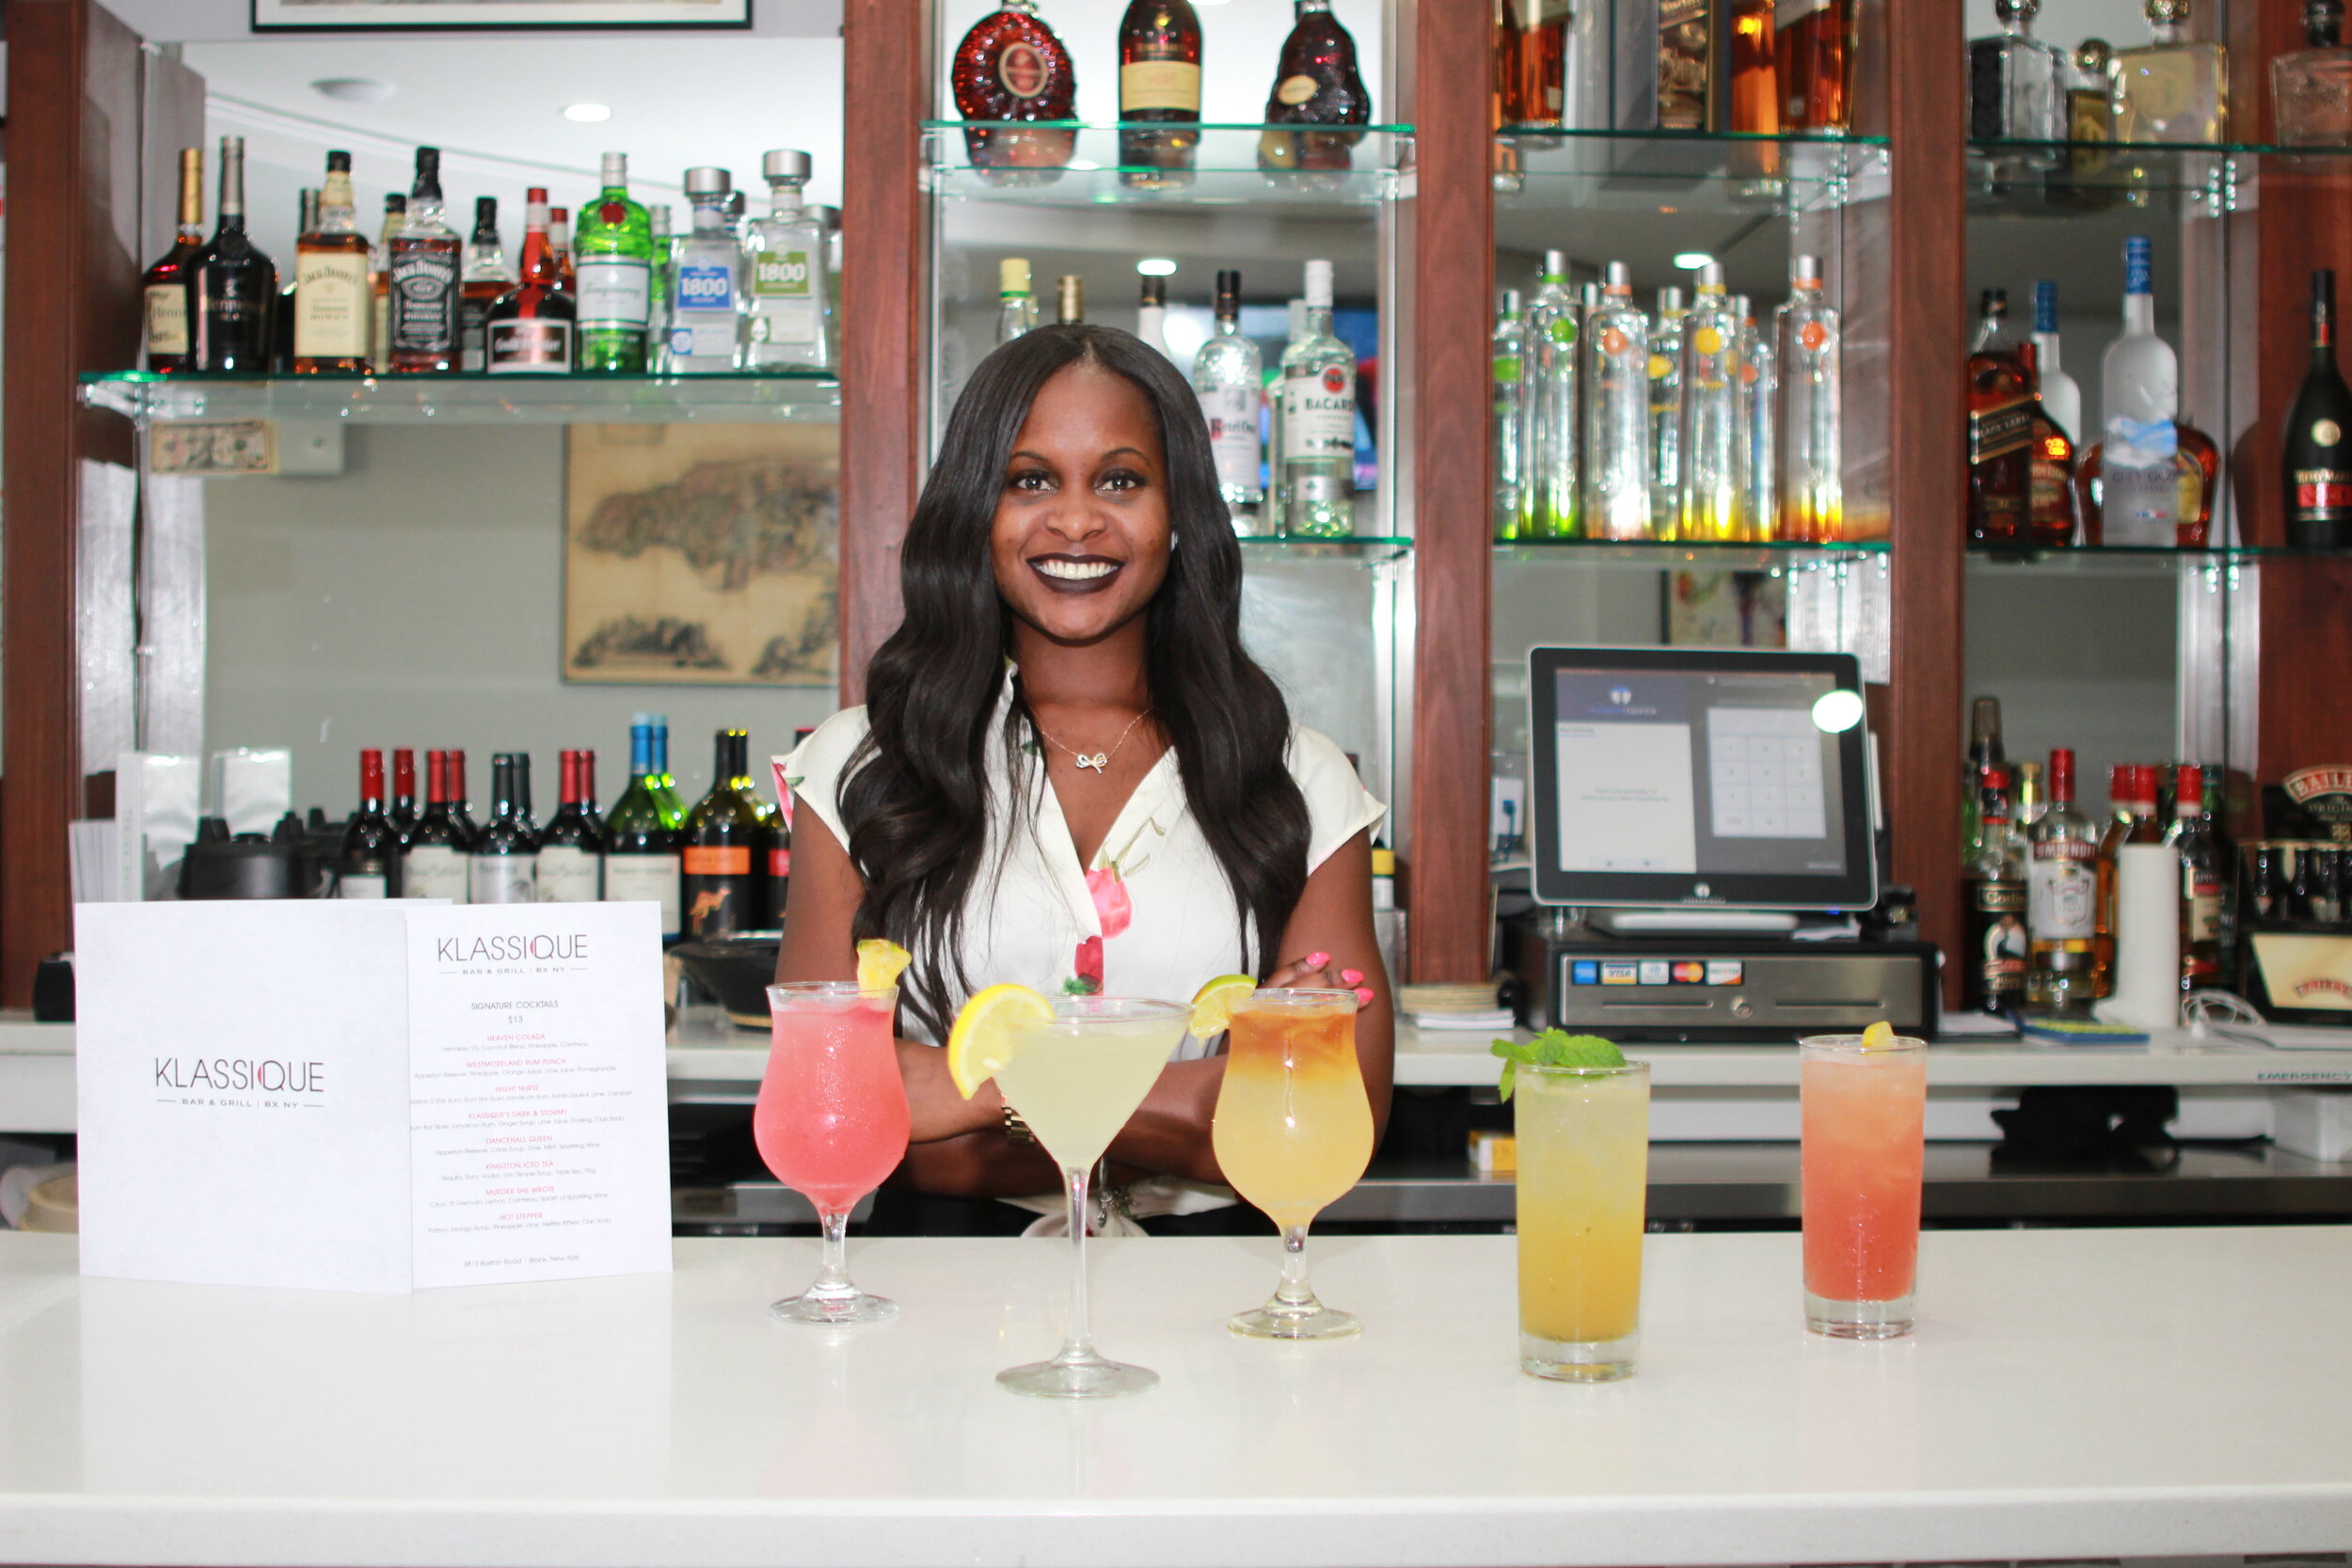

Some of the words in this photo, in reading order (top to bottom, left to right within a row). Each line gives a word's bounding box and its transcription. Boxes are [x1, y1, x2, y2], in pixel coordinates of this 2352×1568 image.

[758, 262, 806, 282] 1800
[680, 277, 727, 296] 1800
[2035, 843, 2096, 858] SMIRNOFF
[437, 934, 588, 962] KLASSIQUE
[1610, 969, 1632, 978] VISA
[470, 1002, 513, 1010] SIGNATURE
[516, 1000, 559, 1009] COCKTAILS
[507, 1015, 524, 1023] $13
[516, 1033, 546, 1041] COLADA
[467, 1059, 524, 1068] WESTMORELAND
[155, 1056, 325, 1093] KLASSIQUE
[2258, 1071, 2352, 1082] EMERGENCY
[220, 1099, 253, 1107] GRILL
[540, 1108, 567, 1117] STORMY
[485, 1136, 526, 1145] DANCEHALL
[528, 1134, 552, 1143] QUEEN
[499, 1212, 514, 1221] HOT
[516, 1212, 543, 1220] STEPPER
